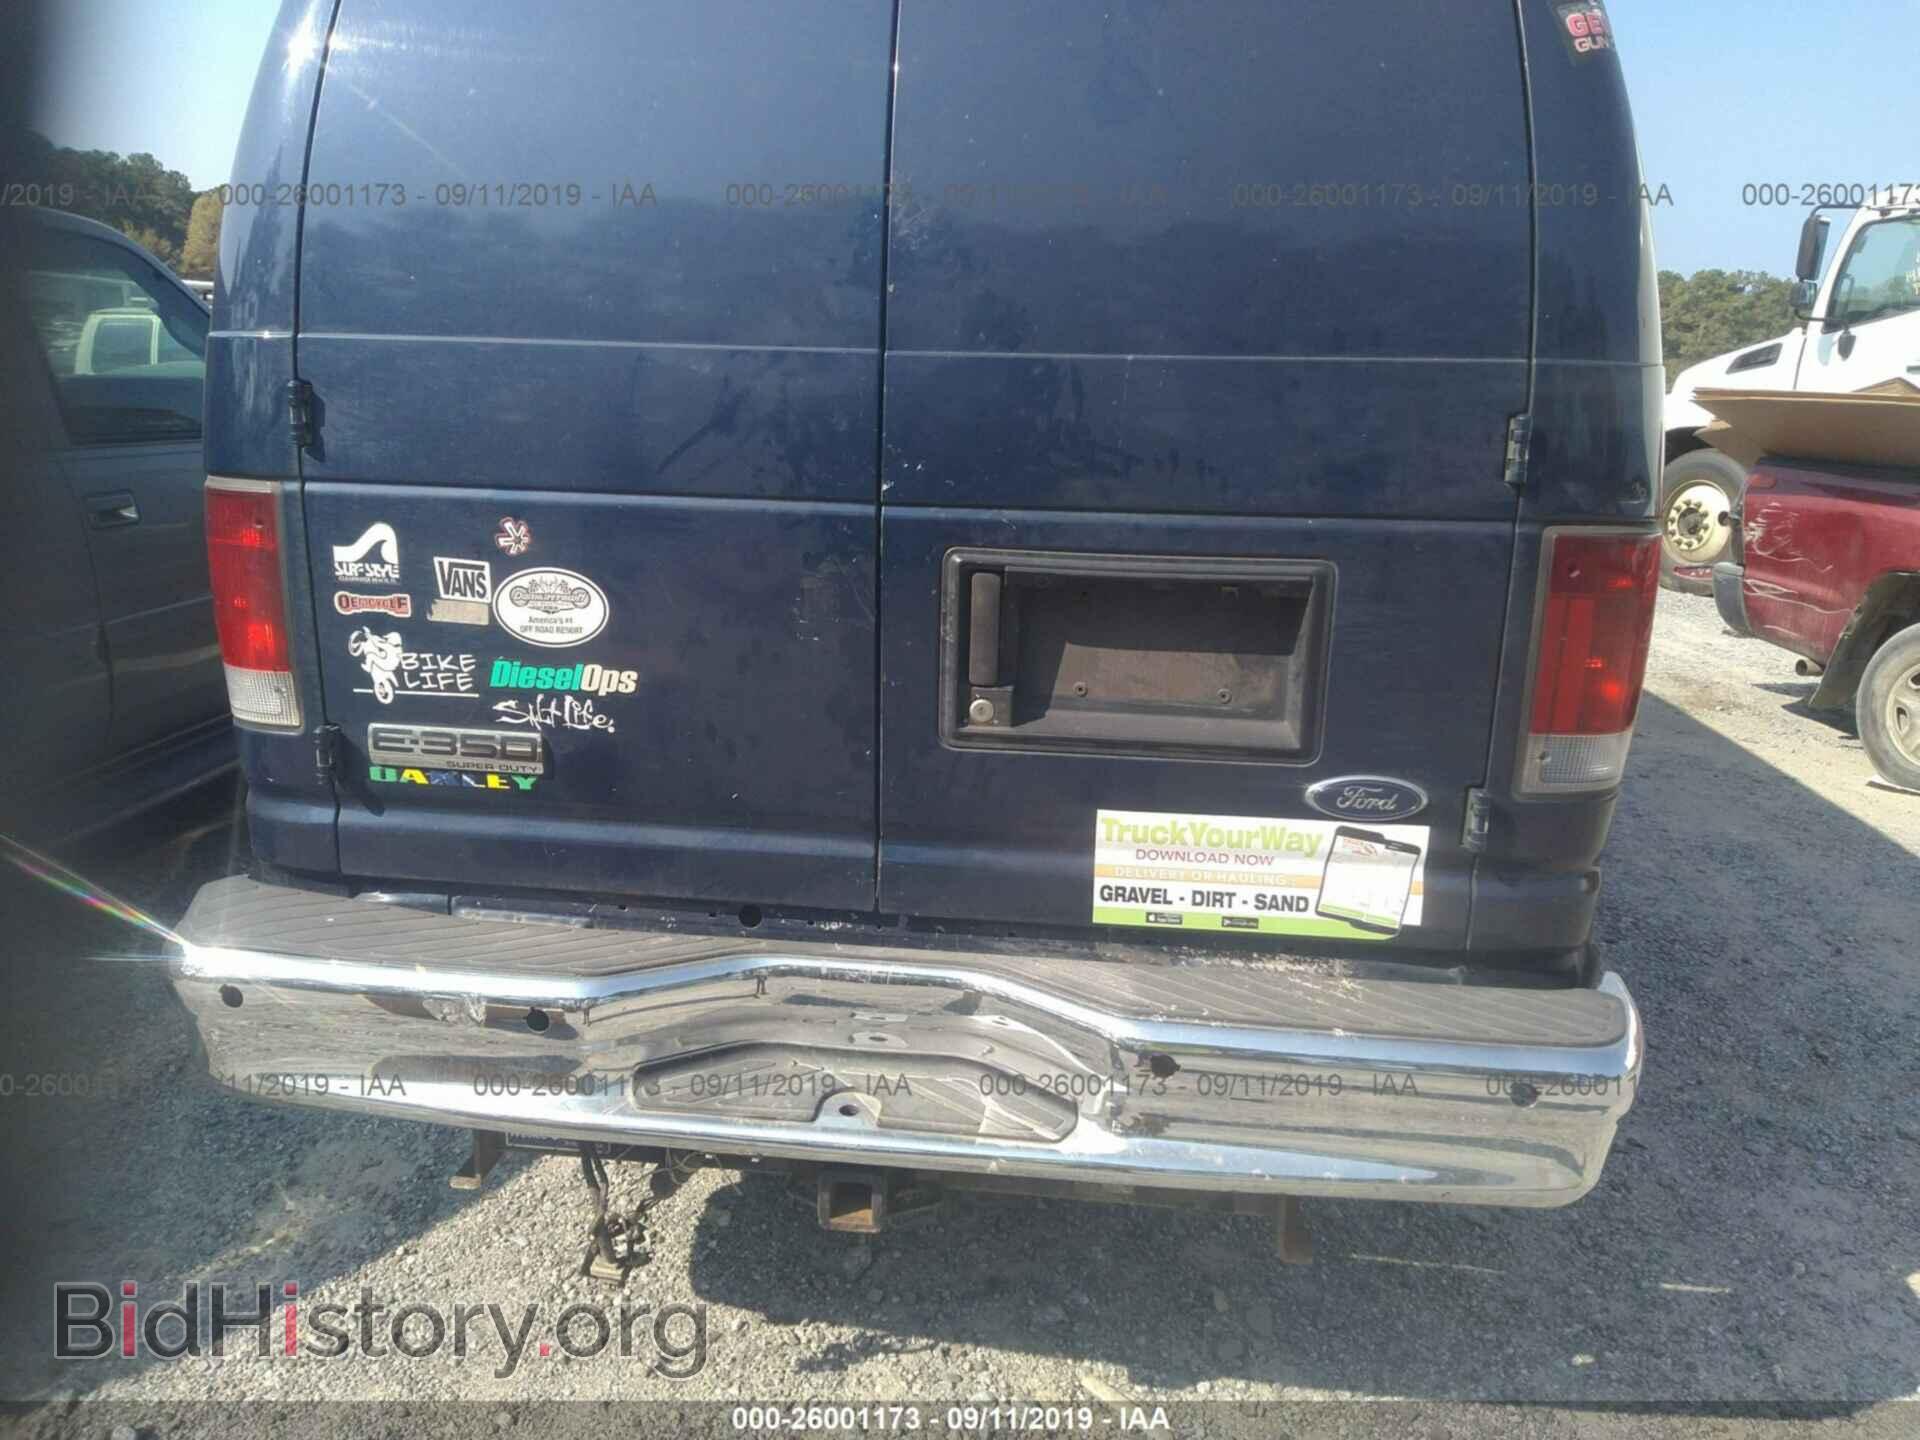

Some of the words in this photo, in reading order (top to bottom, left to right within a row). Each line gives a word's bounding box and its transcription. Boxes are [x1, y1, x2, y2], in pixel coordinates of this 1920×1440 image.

[438, 560, 488, 599] VANS
[534, 626, 554, 634] ROAD
[555, 627, 583, 635] RESORT
[400, 652, 477, 673] BIKE
[403, 671, 474, 692] LIFE
[489, 659, 639, 696] DieselOps
[371, 728, 540, 762] E-350
[446, 761, 495, 771] SUPER
[497, 764, 539, 774] DUTY
[1336, 785, 1399, 811] Ford
[1101, 816, 1324, 858] TruckYourWay
[1135, 848, 1230, 865] DOWNLOAD
[1233, 853, 1276, 867] NOW
[1114, 866, 1185, 882] DELIVERY
[1191, 872, 1211, 882] OR
[1099, 884, 1174, 906] GRAVEL
[1191, 889, 1237, 909] DIRT
[1254, 893, 1310, 913] SAND
